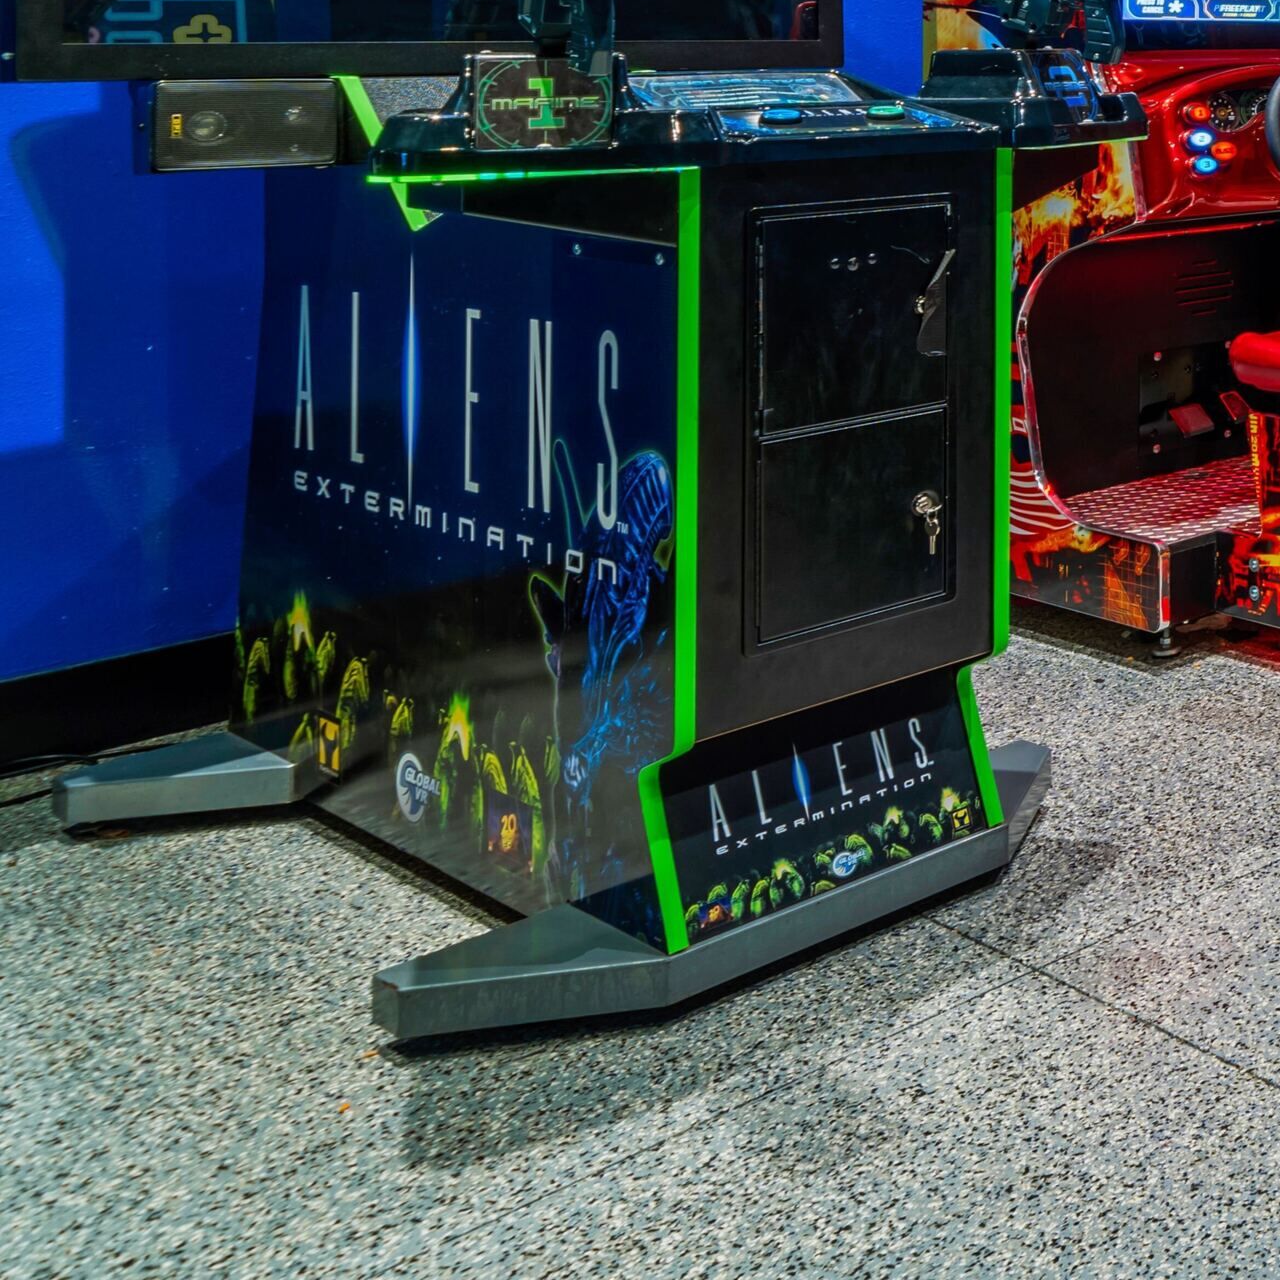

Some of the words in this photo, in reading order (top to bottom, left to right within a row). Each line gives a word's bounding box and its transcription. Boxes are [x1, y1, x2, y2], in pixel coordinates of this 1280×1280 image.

[492, 96, 600, 110] MARINE
[294, 253, 619, 530] ALIENS
[294, 470, 617, 585] EXTERMINATION
[405, 766, 441, 796] GLOBAL
[415, 784, 428, 804] VR
[708, 717, 930, 842] ALIENS
[715, 772, 932, 856] EXTERMINATION
